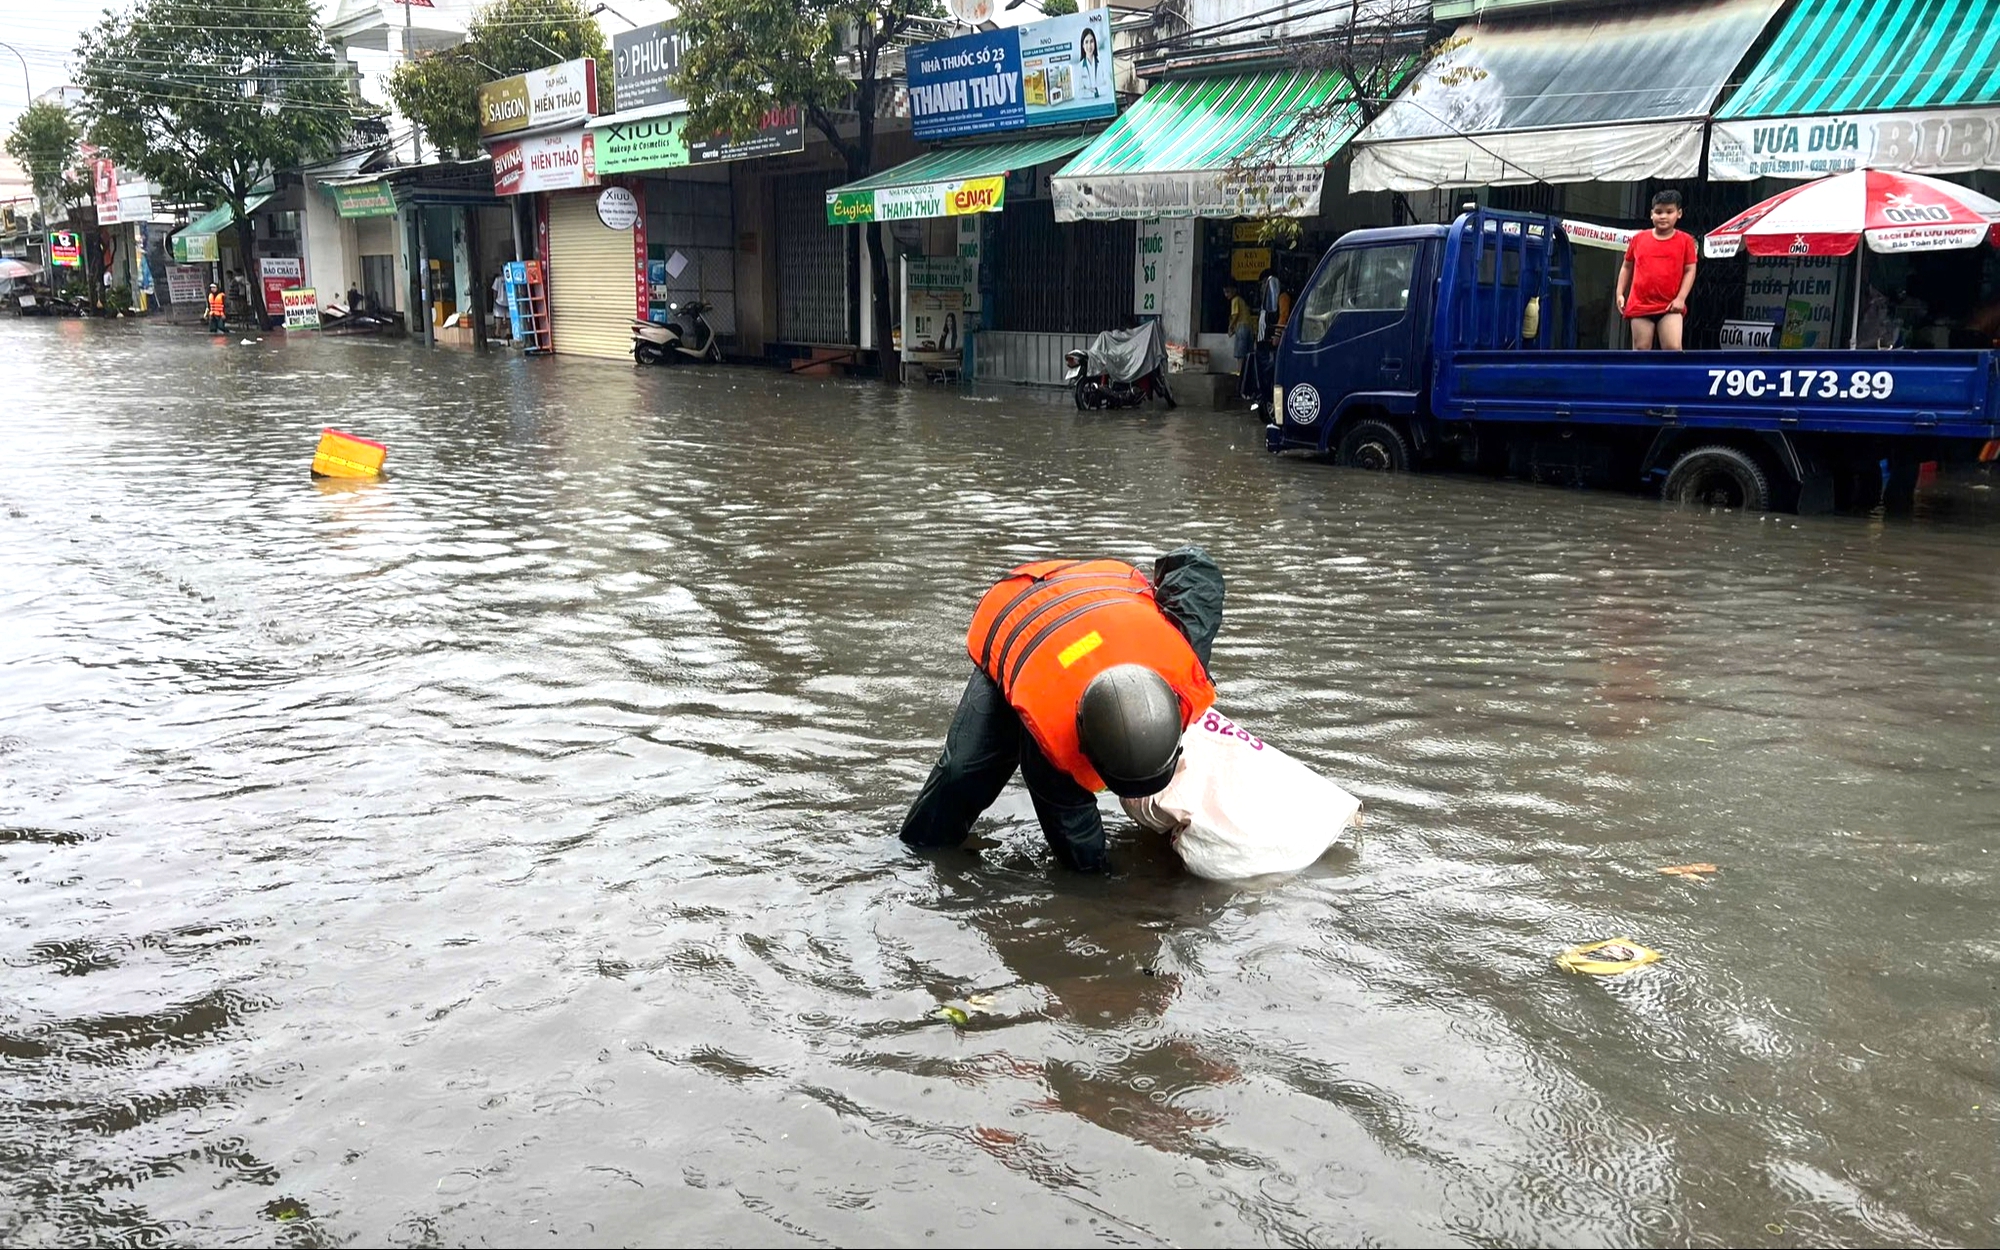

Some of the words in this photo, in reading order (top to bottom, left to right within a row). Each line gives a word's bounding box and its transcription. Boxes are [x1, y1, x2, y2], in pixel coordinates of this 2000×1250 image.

[632, 31, 669, 76] PHÚC
[921, 56, 941, 73] NHÀ
[941, 49, 974, 70] THUỐC
[976, 45, 990, 64] SỐ
[992, 48, 1005, 62] 23
[556, 86, 581, 109] THẢO
[910, 79, 968, 116] THANH
[969, 62, 1019, 109] THỦY
[489, 96, 526, 122] SAIGON
[609, 144, 631, 154] Makeup
[639, 139, 670, 150] Cosmetics
[1753, 125, 1799, 159] VỰA
[1808, 118, 1859, 152] DỪA
[494, 149, 523, 175] BIVINA
[553, 145, 579, 168] THẢO
[833, 200, 872, 220] Eugica
[882, 200, 912, 219] THANH
[914, 193, 940, 217] THỦY
[1885, 206, 1951, 223] OMO
[1138, 231, 1162, 254] THUỐC
[1790, 244, 1807, 253] OMO
[910, 273, 938, 285] THANH
[1143, 293, 1155, 310] 23
[1720, 326, 1743, 346] DỪA
[1748, 331, 1770, 347] 10K
[1708, 369, 1894, 399] 79C-173.89
